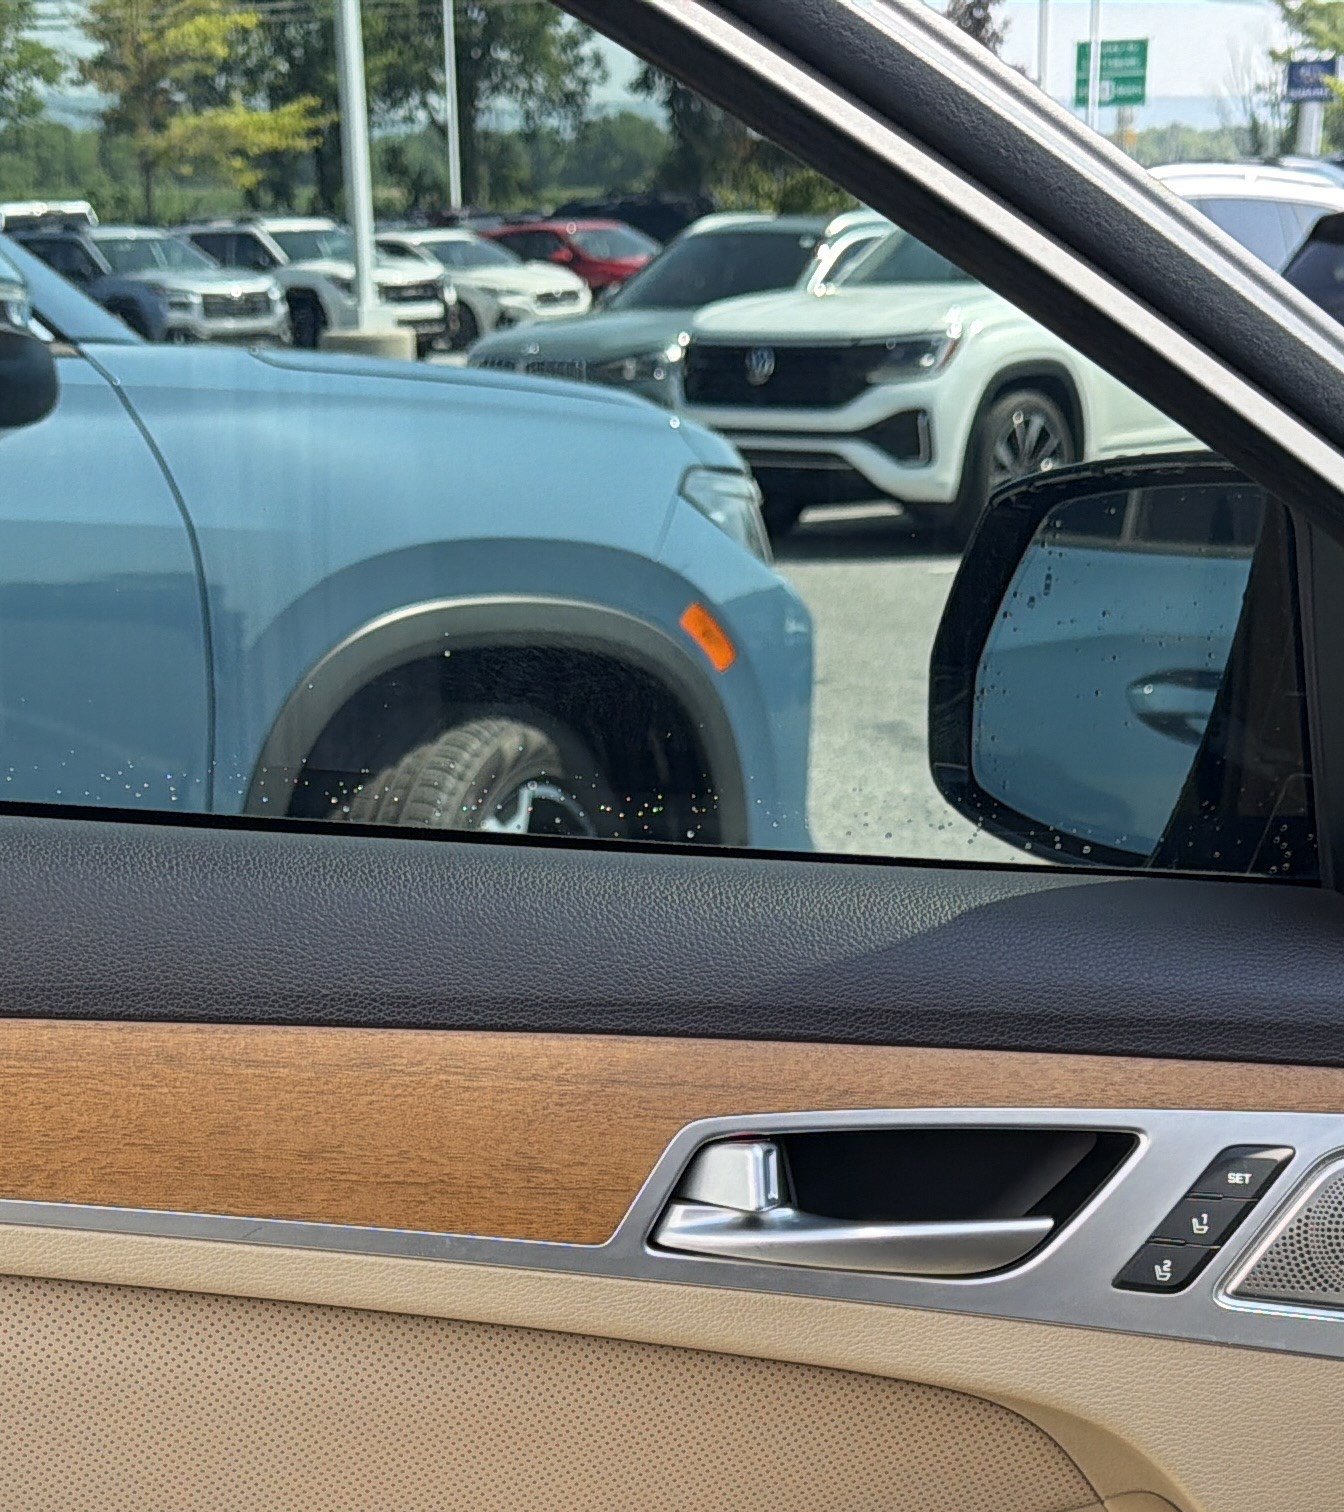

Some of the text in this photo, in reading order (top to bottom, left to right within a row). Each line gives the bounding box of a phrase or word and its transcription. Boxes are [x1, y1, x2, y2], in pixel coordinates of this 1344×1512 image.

[1227, 1172, 1253, 1185] SET
[1200, 1213, 1209, 1225] 1
[1162, 1259, 1173, 1272] 2
